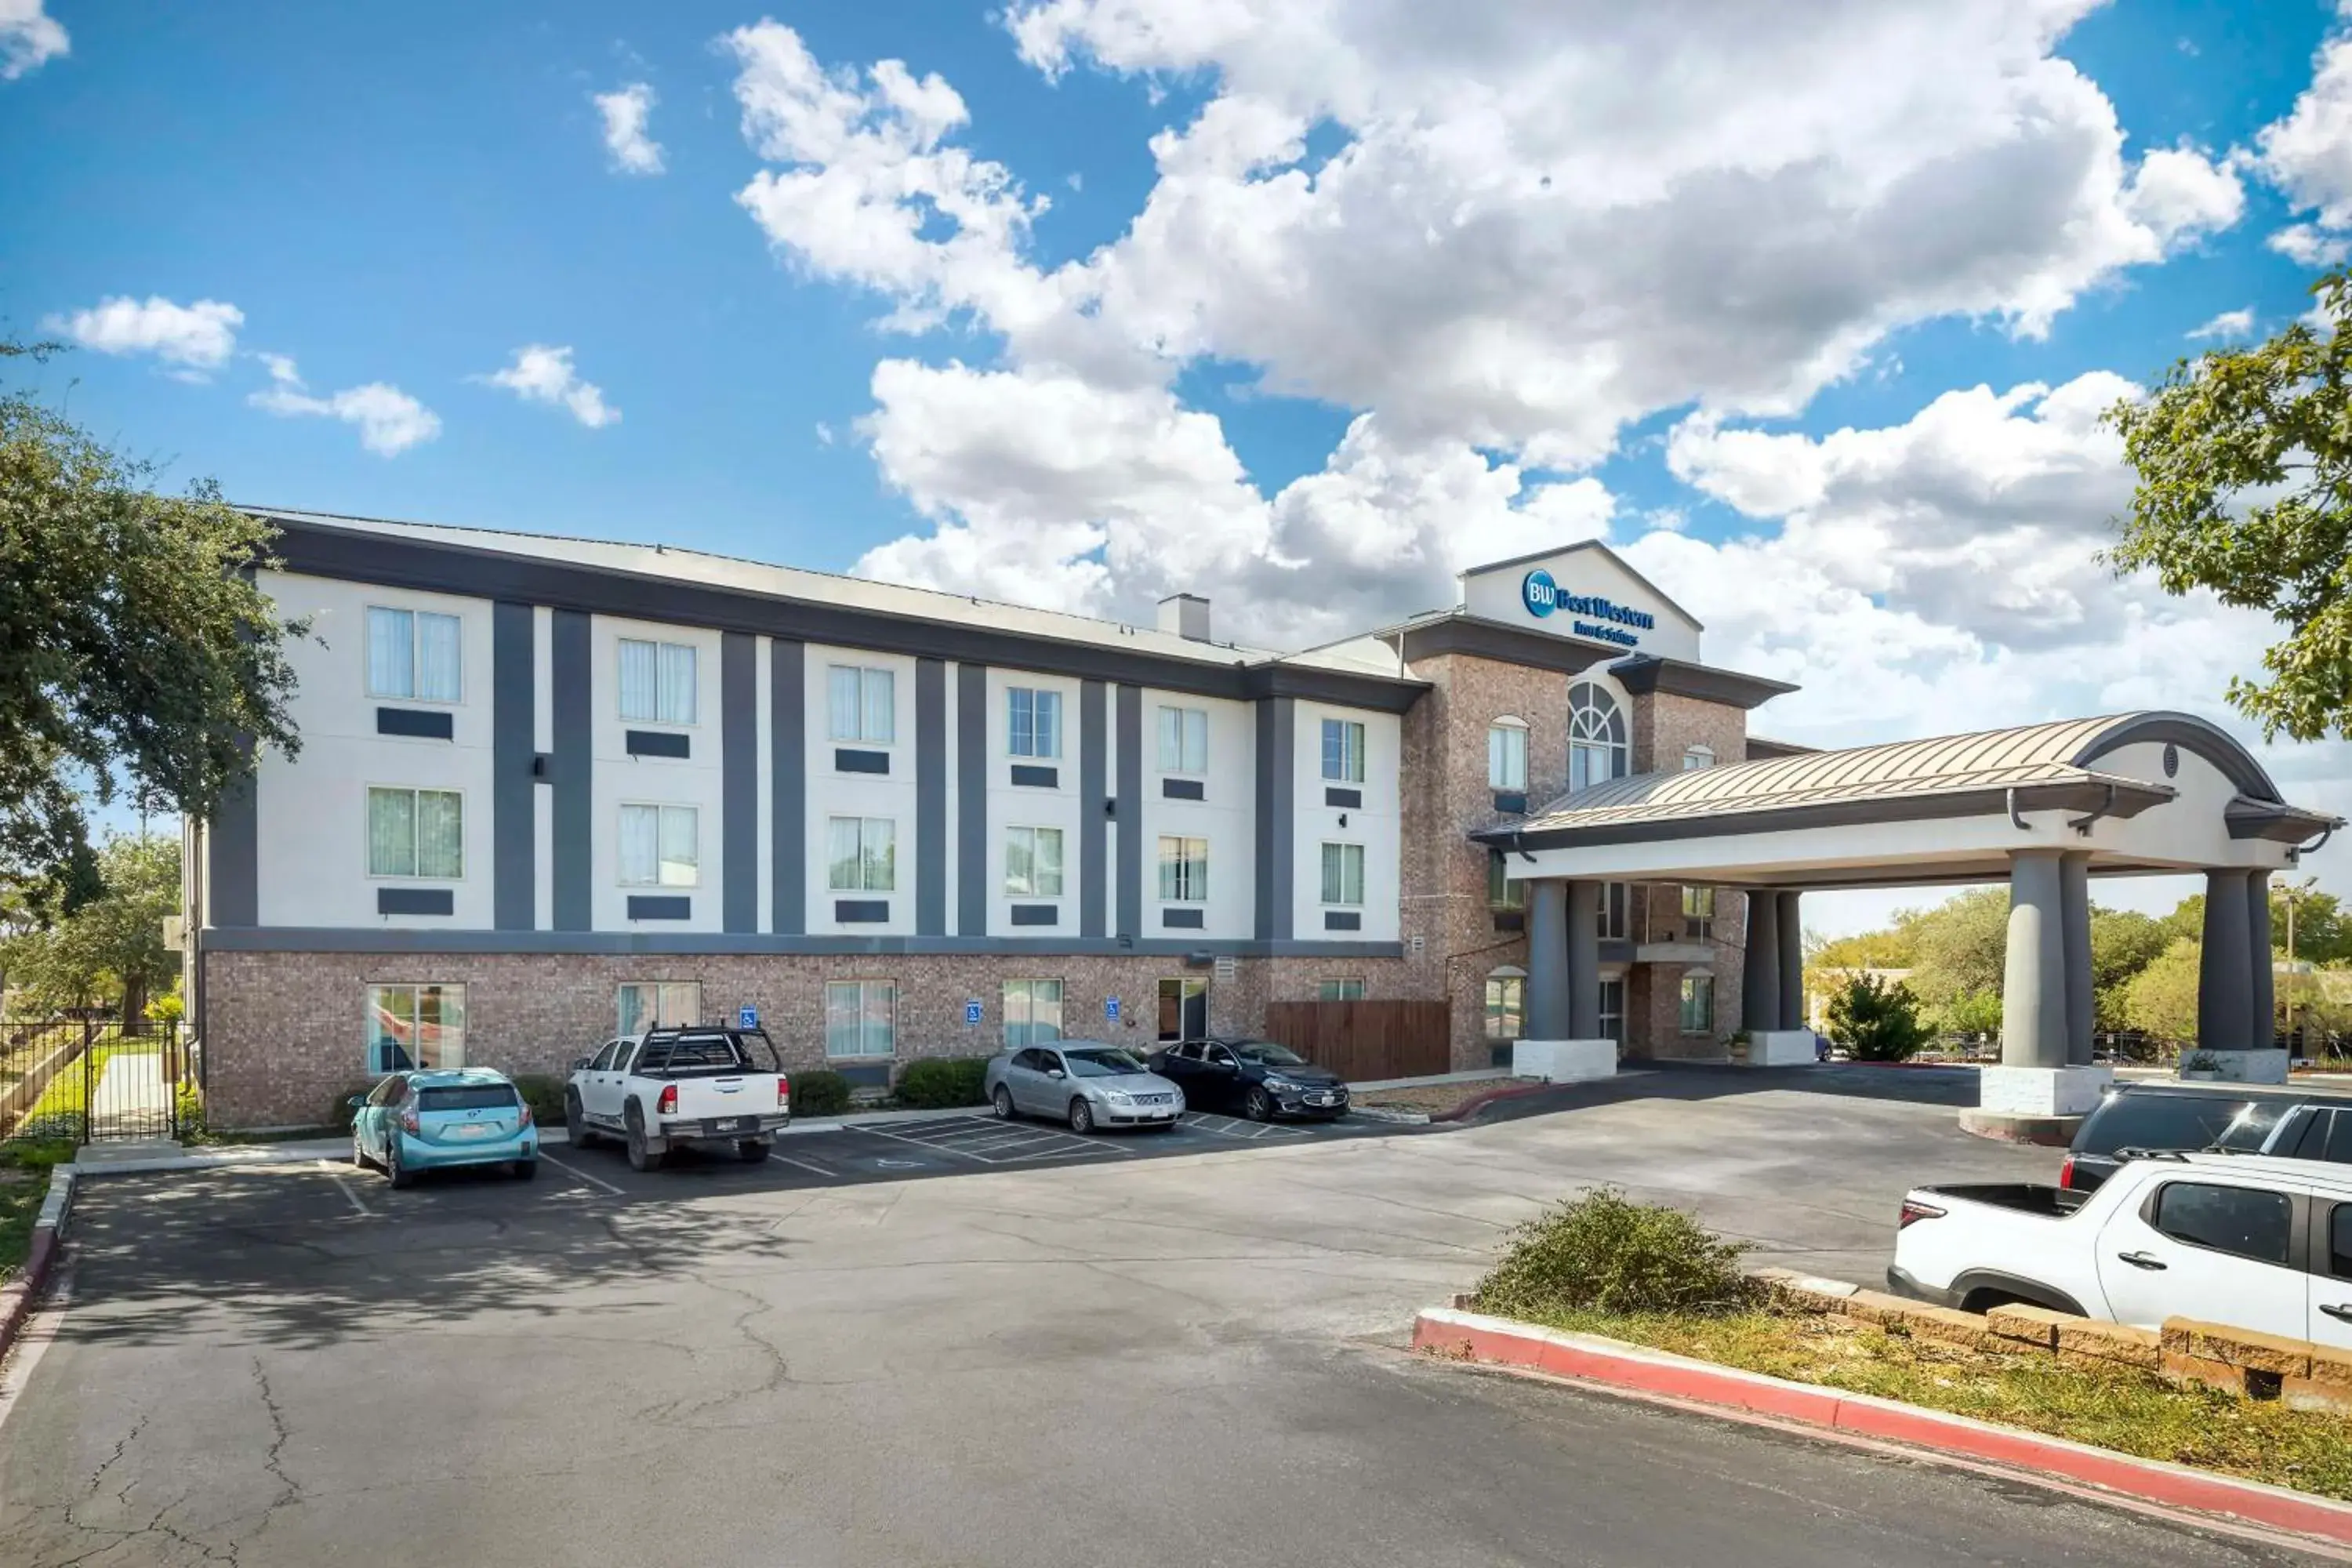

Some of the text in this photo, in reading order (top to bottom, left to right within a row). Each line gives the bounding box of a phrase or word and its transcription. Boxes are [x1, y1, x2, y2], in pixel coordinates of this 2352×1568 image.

[1530, 583, 1555, 605] BW
[1556, 590, 1655, 630] Best Western
[1573, 620, 1595, 637] Inn
[1604, 627, 1639, 646] Suites
